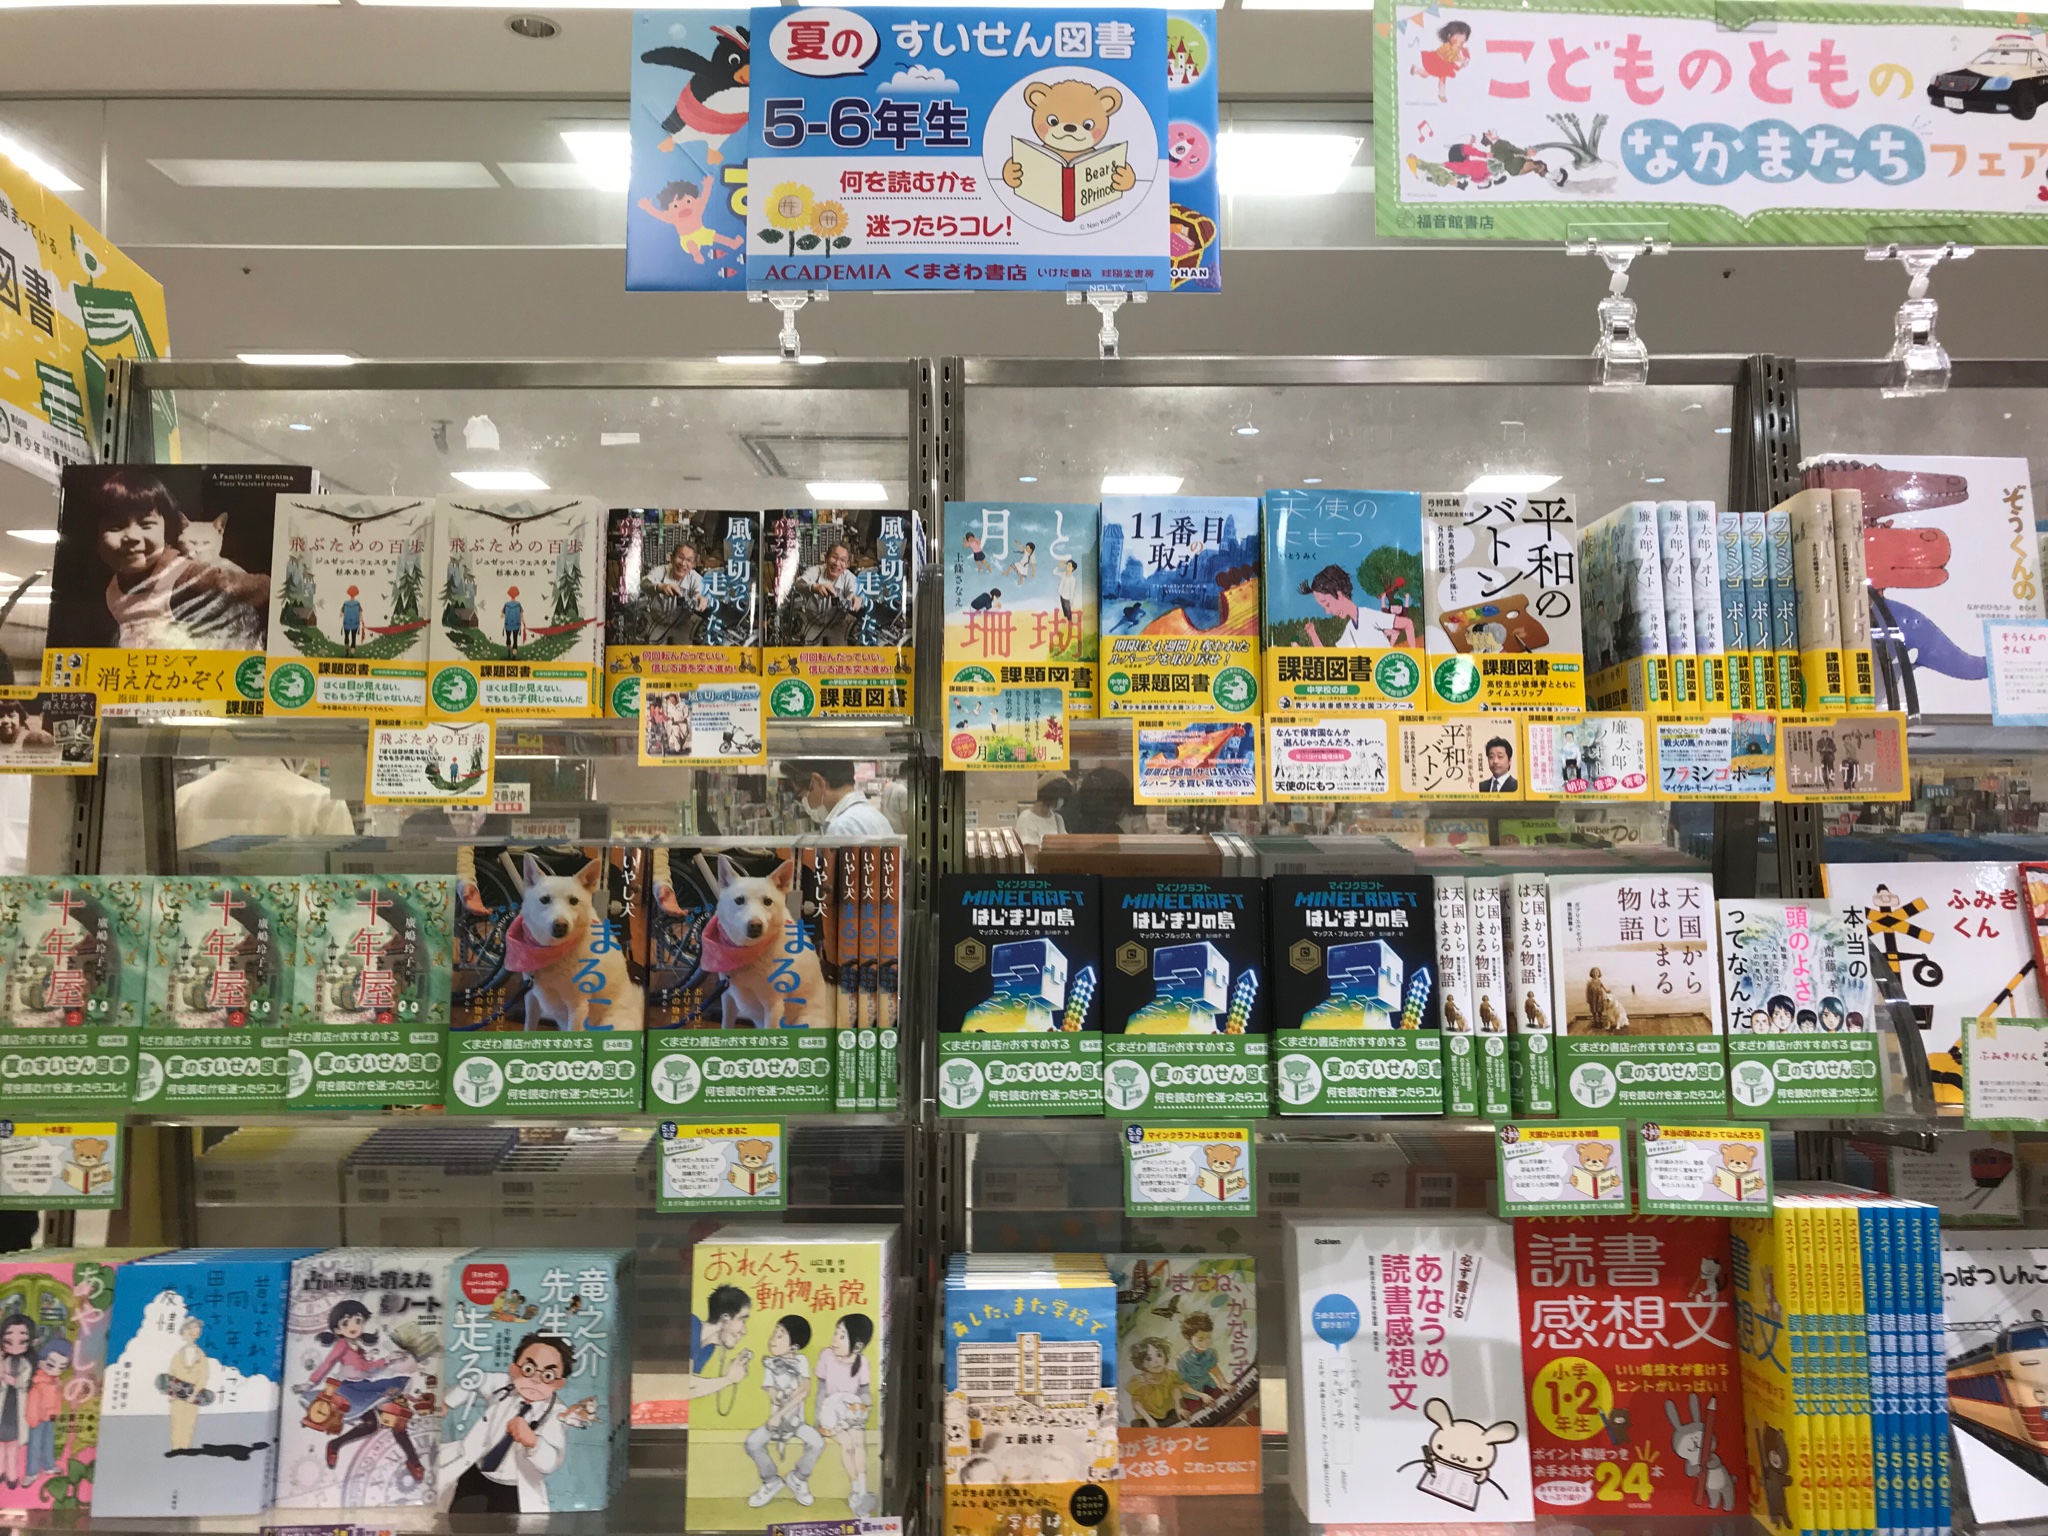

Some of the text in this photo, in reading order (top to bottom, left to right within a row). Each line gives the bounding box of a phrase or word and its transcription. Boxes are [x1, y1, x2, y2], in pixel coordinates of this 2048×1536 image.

[787, 20, 1136, 60] 夏の すいせん図書
[1484, 33, 1915, 109] こどものともの
[763, 98, 969, 151] 5-6年生
[839, 170, 977, 195] 何を読むかを
[1085, 166, 1109, 182] Bear
[866, 215, 1012, 238] 迷ったらコレ!
[1100, 211, 1122, 226] Komiya
[1416, 214, 1495, 230] 福音館書店
[765, 264, 893, 281] ACADEMIA
[903, 262, 1027, 283] くまざわ書店
[1038, 268, 1092, 278] いけだ書店
[219, 473, 243, 481] Family
[1272, 497, 1378, 520] 天使の
[289, 538, 424, 554] 飛ぶための百歩
[450, 538, 584, 554] 飛ぶための百歩
[981, 508, 1072, 561] 月と
[2002, 484, 2037, 602] ぞうくんの
[1463, 497, 1523, 598] バトン
[1522, 497, 1574, 618] 平和の
[727, 517, 752, 611] 風を切って
[880, 516, 904, 611] 風を切って
[1149, 543, 1199, 580] 取引
[961, 609, 1084, 659] 珊瑚
[127, 653, 198, 667] ヒロシマ
[319, 663, 369, 675] 課題図書
[480, 665, 531, 677] 課題図書
[1278, 656, 1372, 682] 課題図書
[1483, 659, 1550, 676] 課題図書
[97, 667, 225, 692] 消えたかぞく
[1131, 673, 1210, 693] 課題図書
[1487, 680, 1576, 689] 高校生が被爆者とともに
[1657, 659, 1669, 701] 課題図書
[1686, 659, 1696, 701] 課題図書
[1714, 659, 1724, 701] 課題図書
[1825, 652, 1841, 694] 課題図書
[1856, 652, 1871, 694] 課題図書
[323, 682, 401, 692] ぼくは目が見えない。
[323, 692, 422, 702] でももう子供じゃないんだ
[486, 683, 562, 693] ぼくは目が見えない。
[486, 693, 583, 704] でももう子供じゃないんだ
[821, 688, 907, 707] 課題図書
[1307, 686, 1348, 694] 中学校の部
[1487, 689, 1543, 698] タイムスリップ
[1295, 702, 1414, 710] 青少年読書感想文全国コンクール
[379, 732, 486, 746] 飛ぶための百歩
[1276, 728, 1350, 737] なんで保育園なんか
[1418, 739, 1444, 791] バトン
[1441, 724, 1465, 781] 平和の
[1663, 766, 1773, 782] フラミンゴボーイ
[1791, 762, 1876, 784] キャパとゲルダ
[1275, 781, 1335, 792] 天使のにもつ
[620, 854, 635, 918] いやし犬
[813, 856, 829, 918] いやし犬
[843, 851, 855, 899] いやし犬
[862, 851, 875, 899] いやし犬
[883, 851, 895, 899] いやし犬
[996, 880, 1051, 889] マインクラフト
[1328, 881, 1383, 890] マインクラフト
[962, 890, 1085, 906] MINECRAFT
[1156, 884, 1211, 892] マインクラフト
[1295, 892, 1417, 908] MINECRAFT
[1947, 889, 2018, 911] ふみき
[1122, 894, 1244, 910] MINECRAFT
[1618, 887, 1644, 941] 物語
[973, 908, 1075, 926] はじまりの島
[1133, 911, 1235, 930] はじまりの島
[1306, 909, 1409, 928] はじまりの島
[1451, 886, 1466, 952] 天国から
[1486, 886, 1501, 952] 天国から
[1531, 883, 1547, 949] 天国から
[1953, 917, 2000, 939] くん
[1437, 888, 1455, 988] はじまる物語
[1473, 887, 1490, 988] はじまる物語
[1518, 884, 1536, 985] はじまる物語
[1651, 887, 1674, 994] はじまる
[1676, 886, 1702, 994] 天国から
[1843, 905, 1868, 979] 本当の
[40, 889, 86, 1007] 十年屋
[202, 889, 247, 1009] 十年屋
[350, 889, 396, 1009] 十年屋
[572, 918, 623, 1031] まるこ
[767, 918, 816, 1030] まるこ
[1725, 910, 1752, 1029] ってなんだ
[318, 1054, 440, 1070] 夏のすいせん図書
[508, 1063, 634, 1078] 夏のすいせん図書
[707, 1060, 828, 1077] 夏のすいせん図書
[1619, 1064, 1723, 1080] 夏のすいせん図書
[1776, 1062, 1876, 1078] 夏のすいせん図書
[1528, 1232, 1665, 1287] 読書
[538, 1267, 573, 1338] 先生
[752, 1277, 867, 1313] 動物病院
[571, 1267, 609, 1377] 竜之介
[1415, 1254, 1450, 1377] あなうめ
[1531, 1294, 1732, 1350] 感想文
[1381, 1254, 1418, 1411] 読書感想文
[1552, 1363, 1588, 1380] 小学
[1615, 1364, 1729, 1377] いい感想文が書ける
[1554, 1417, 1590, 1433] 年生
[1595, 1462, 1654, 1502] 24
